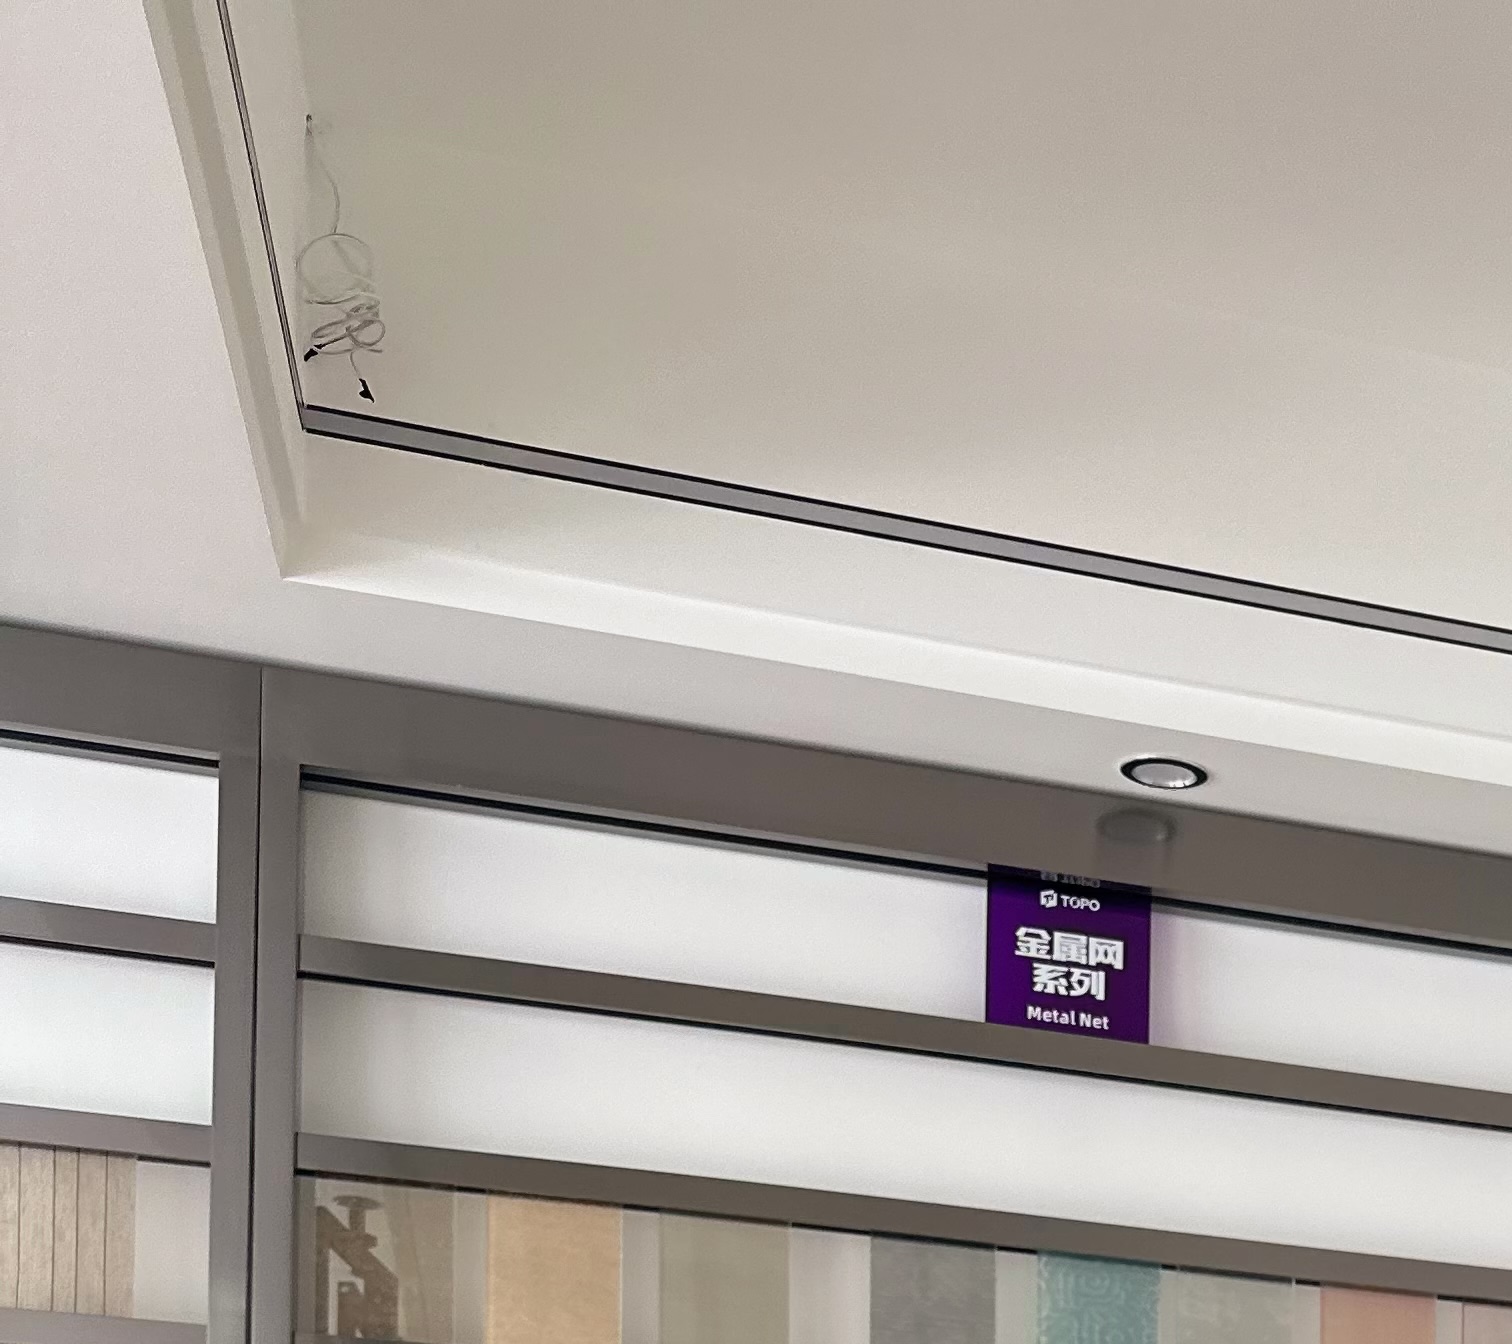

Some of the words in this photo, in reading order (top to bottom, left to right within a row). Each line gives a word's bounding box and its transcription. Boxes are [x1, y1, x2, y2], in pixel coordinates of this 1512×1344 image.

[1060, 894, 1101, 912] TOPO
[1014, 926, 1125, 971] 金属网
[1032, 962, 1106, 1001] 系列
[1027, 1005, 1076, 1026] Metal
[1079, 1012, 1110, 1031] Net
